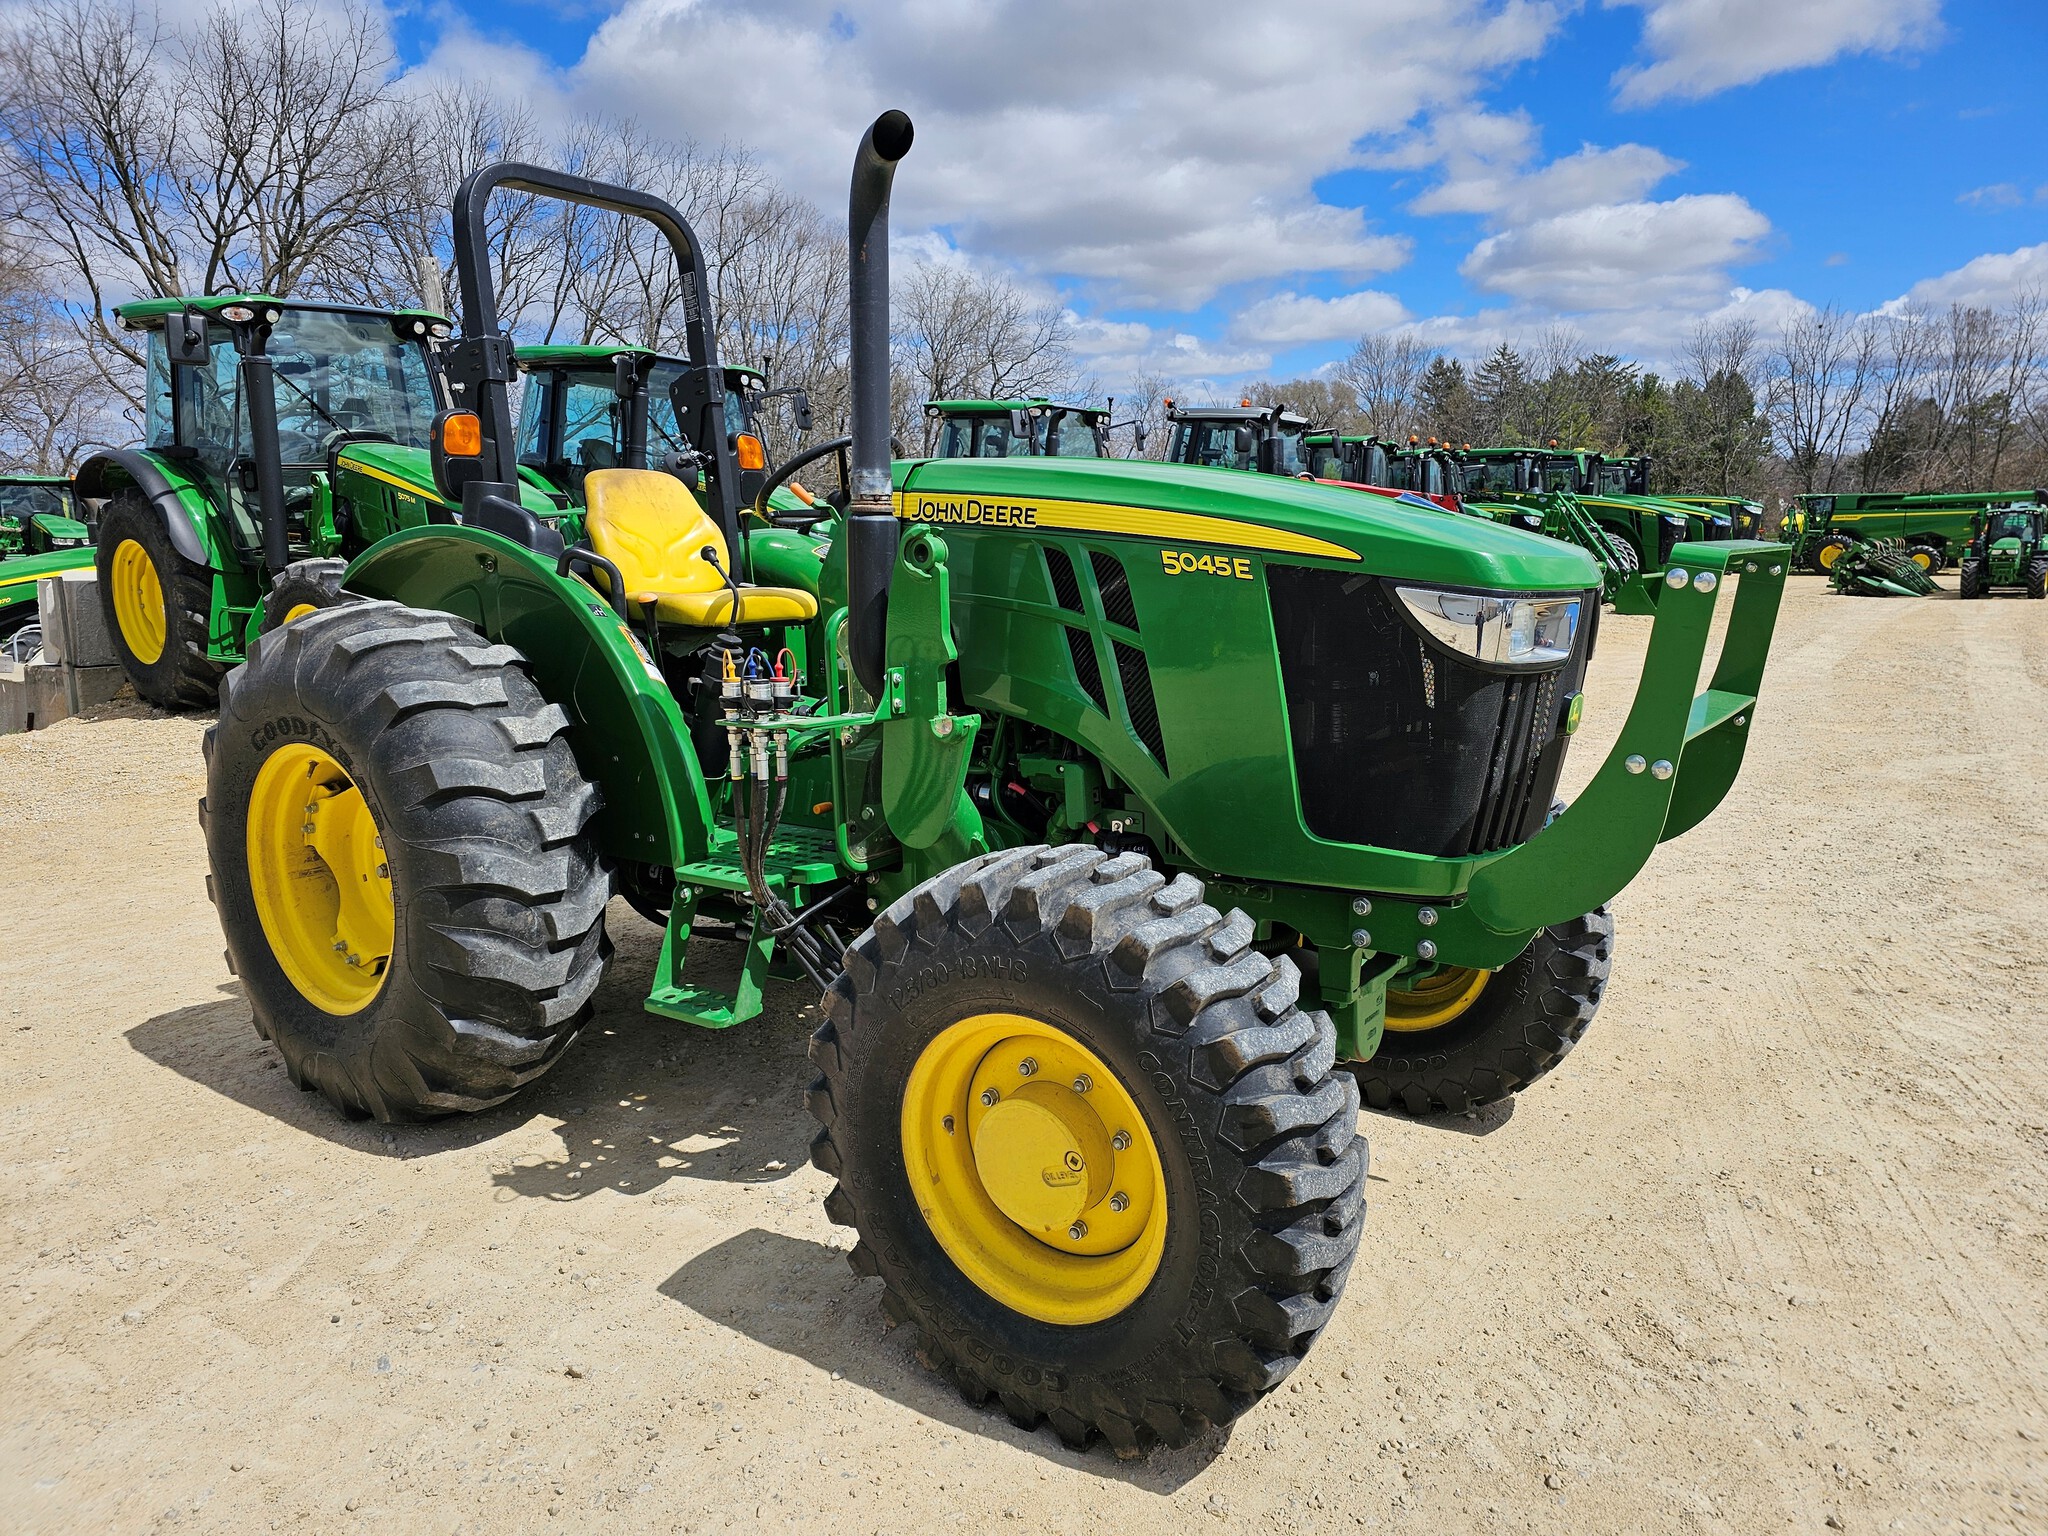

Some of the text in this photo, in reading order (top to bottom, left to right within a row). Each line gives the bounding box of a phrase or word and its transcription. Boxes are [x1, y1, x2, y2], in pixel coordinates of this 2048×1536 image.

[911, 497, 1038, 527] JOHN DEERE
[981, 954, 1030, 984] NHS
[868, 1211, 1069, 1392] GOODYEAR
